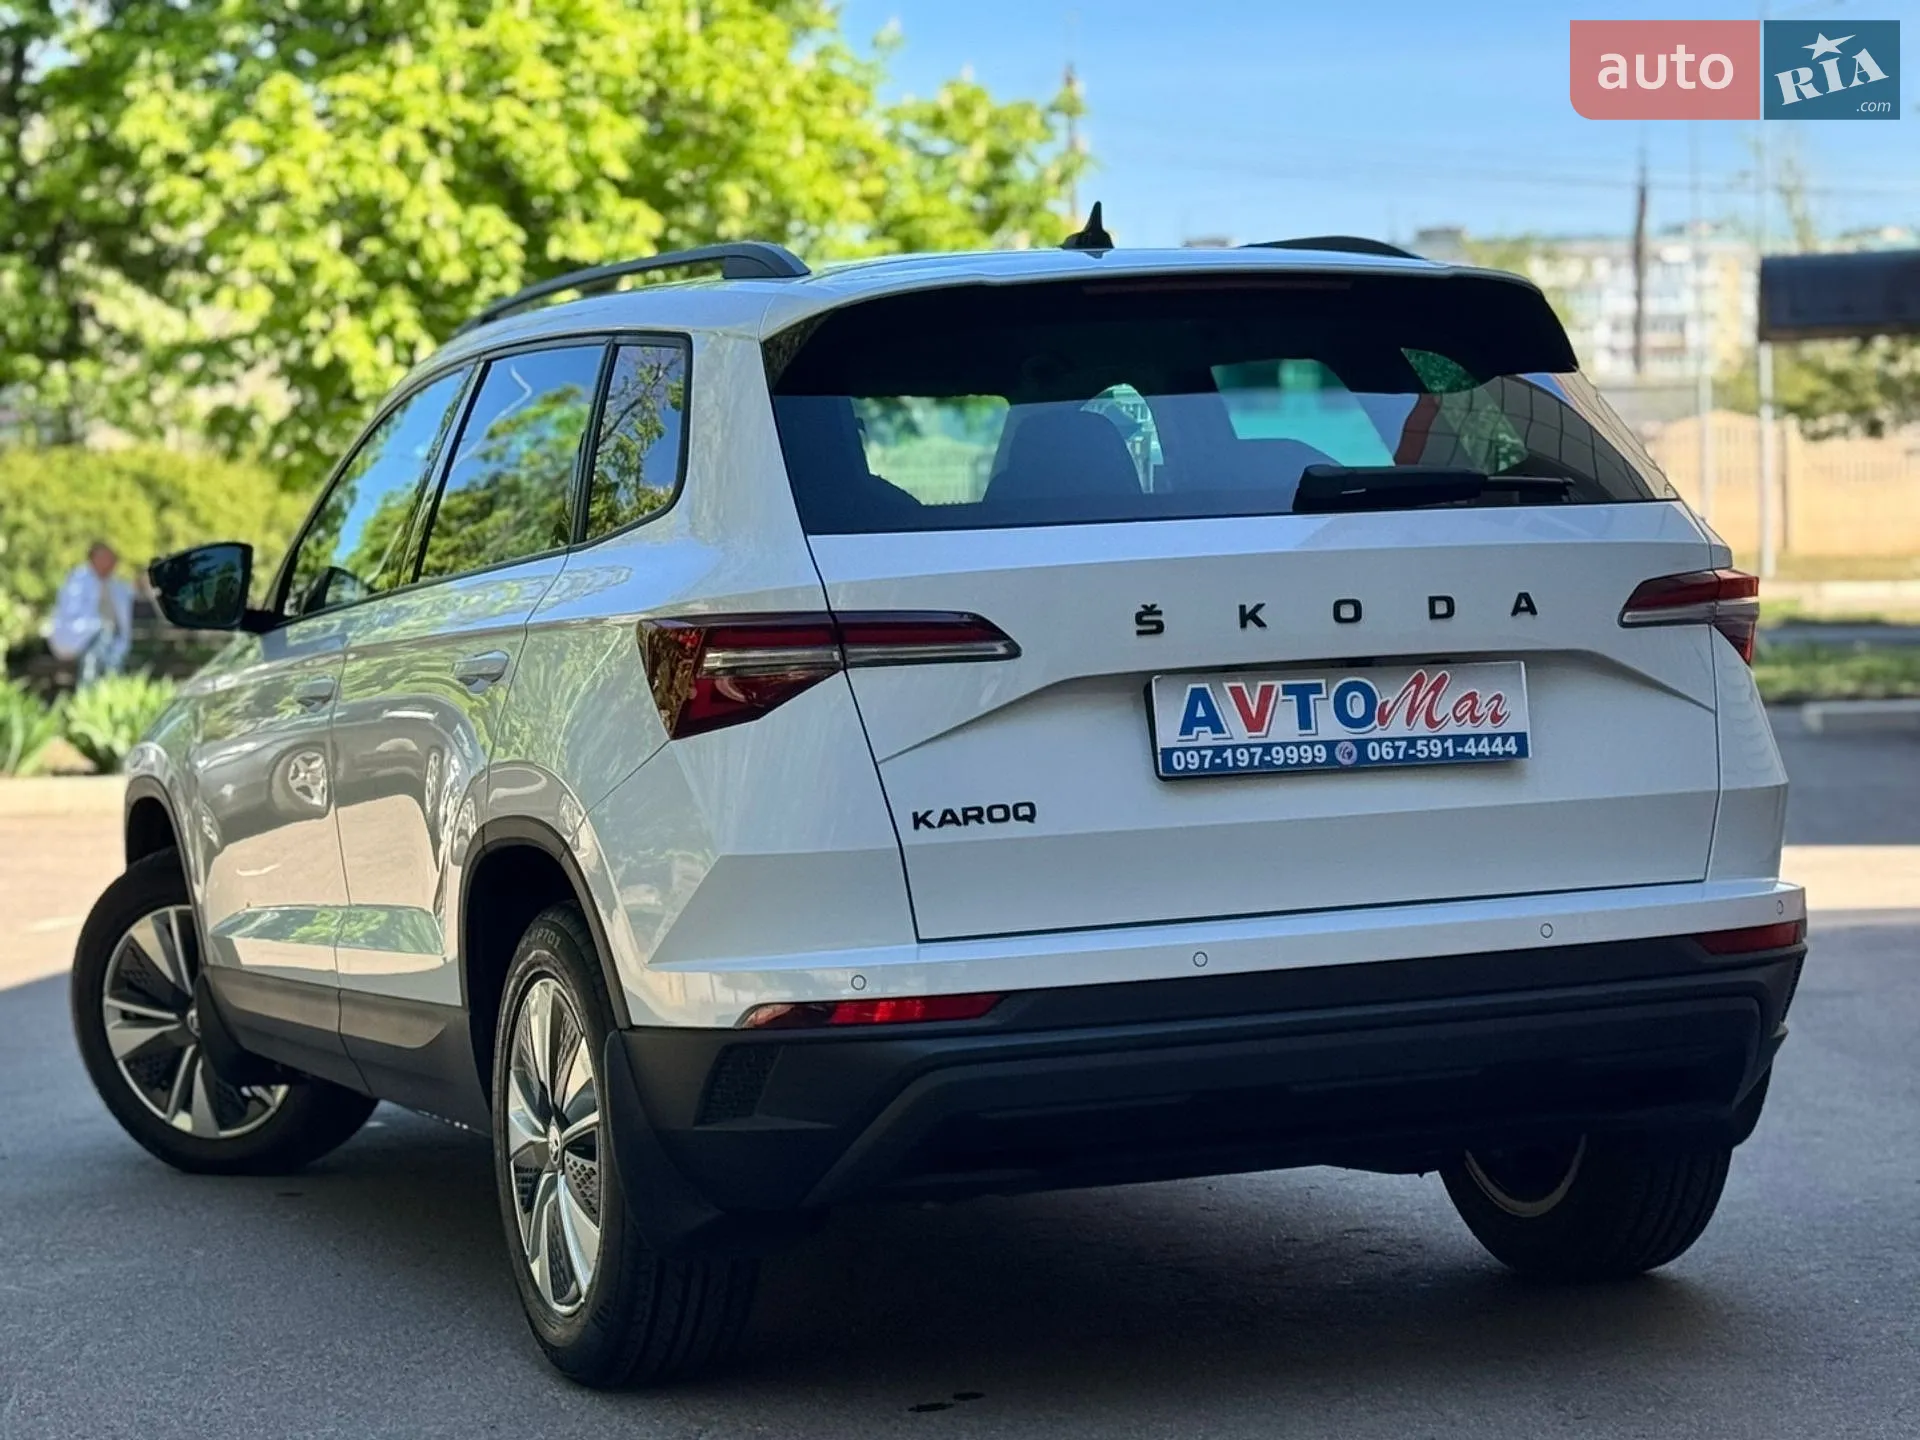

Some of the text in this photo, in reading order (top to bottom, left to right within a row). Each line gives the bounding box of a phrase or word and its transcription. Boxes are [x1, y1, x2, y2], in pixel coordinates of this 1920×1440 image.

[1135, 591, 1538, 636] ŠKODA
[1172, 735, 1518, 771] 097-197-9999 067-591-4444
[912, 801, 1037, 831] KAROQ
